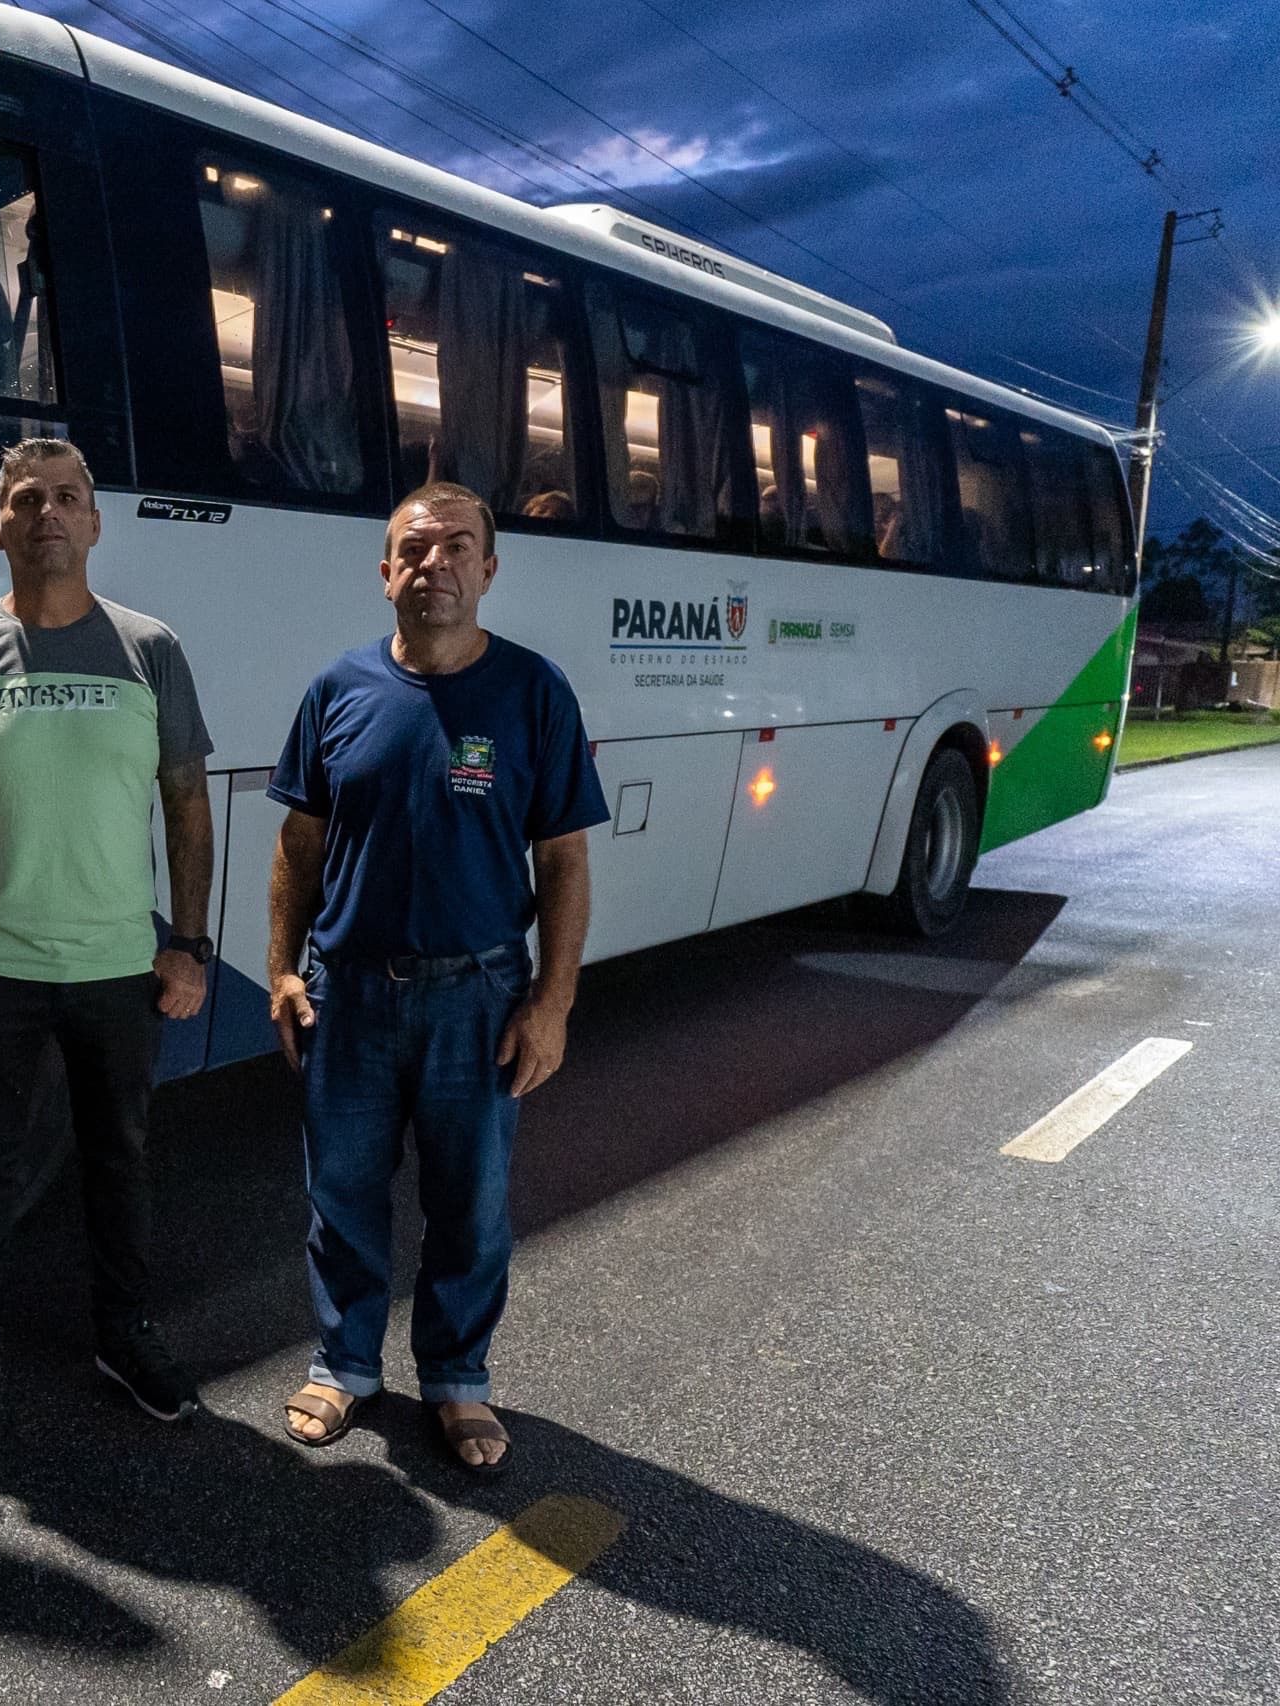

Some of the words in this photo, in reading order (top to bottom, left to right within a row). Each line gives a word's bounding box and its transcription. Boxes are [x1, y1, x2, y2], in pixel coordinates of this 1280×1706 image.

[641, 234, 726, 279] SPHEROS
[169, 508, 205, 520] FLY
[208, 511, 225, 522] 12
[612, 597, 722, 641] PARANÁ
[830, 622, 855, 637] SEMSA
[610, 654, 672, 664] GOVERNO
[681, 655, 696, 664] DO
[705, 655, 747, 664] ESTADO
[634, 674, 684, 687] SECRETARIA
[686, 674, 698, 686] DA
[699, 672, 725, 686] SAÚDE
[451, 777, 492, 788] MOTORISTA
[454, 785, 486, 795] DANIEL
